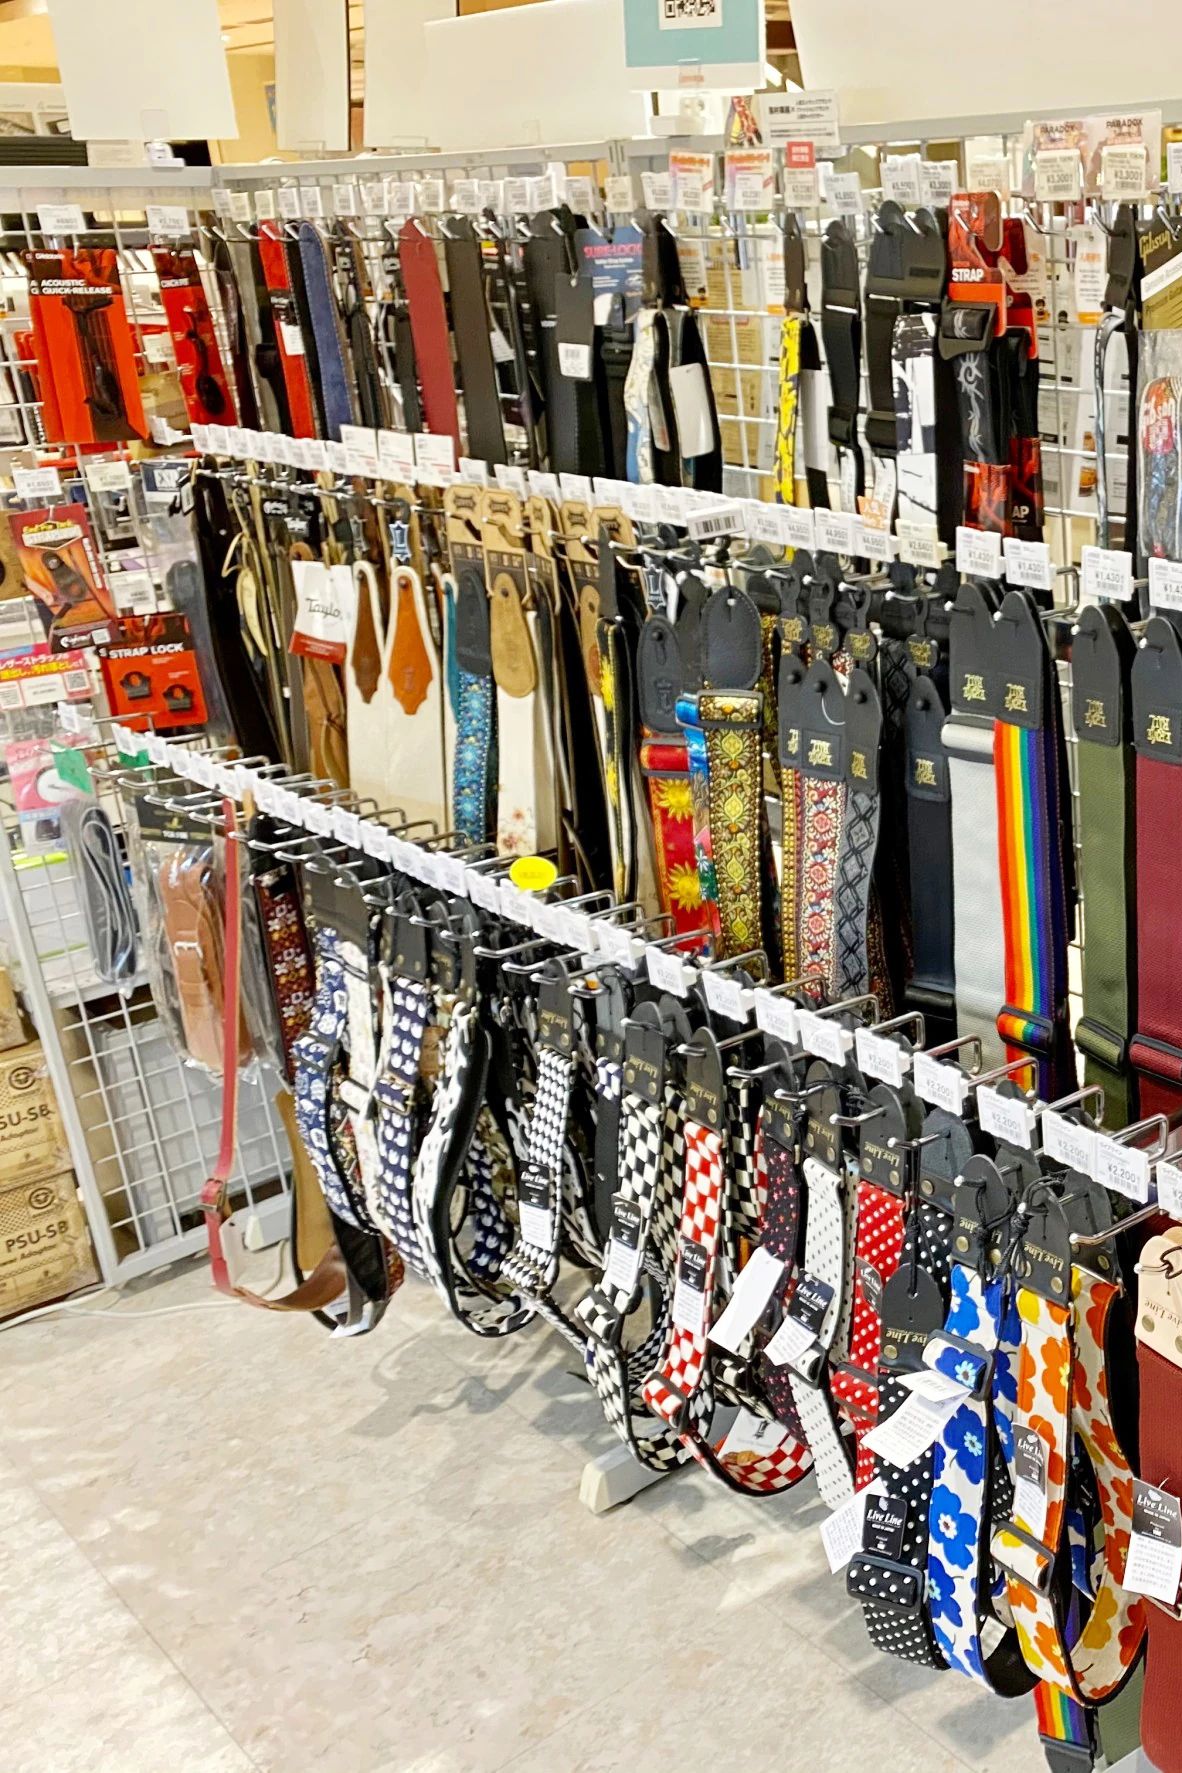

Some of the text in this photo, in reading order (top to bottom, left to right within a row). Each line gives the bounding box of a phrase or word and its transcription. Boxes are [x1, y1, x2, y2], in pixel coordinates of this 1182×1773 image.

[1106, 118, 1143, 128] PARADOX
[1139, 230, 1172, 268] Gibson
[41, 279, 86, 287] ACOUSTIC
[951, 268, 984, 282] STRAP
[42, 287, 113, 295] QUICK-RELEASE
[305, 596, 343, 620] Taylo
[109, 642, 185, 659] STRAP LOCK
[0, 1103, 52, 1130] SU-SB
[1107, 1161, 1137, 1184] ¥2,200
[6, 1221, 69, 1253] PSU-SB
[1144, 1299, 1168, 1319] Line
[1137, 1493, 1178, 1519] Live Line
[867, 1508, 903, 1526] Live Line
